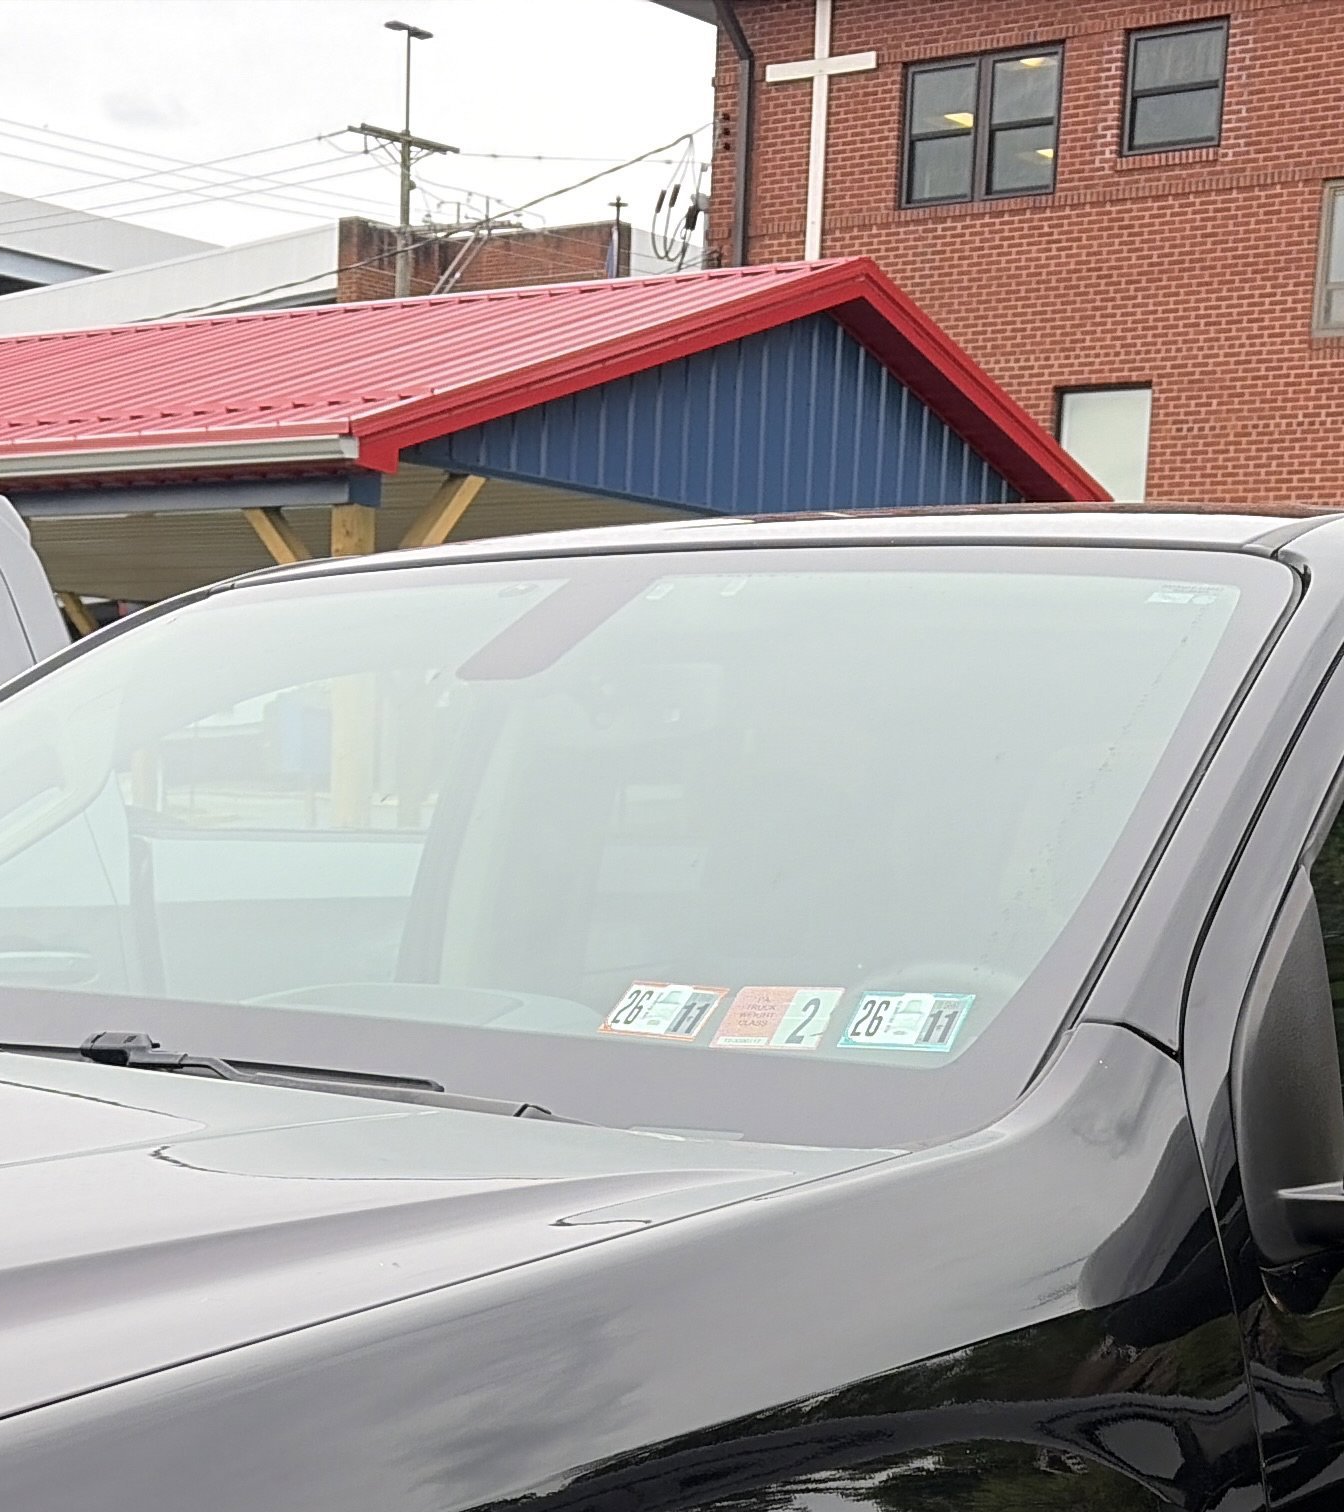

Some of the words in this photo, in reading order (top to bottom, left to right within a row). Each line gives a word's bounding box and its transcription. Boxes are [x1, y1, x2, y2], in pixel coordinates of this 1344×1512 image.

[610, 989, 655, 1025] 26
[671, 1002, 711, 1034] 11
[738, 1019, 769, 1027] CLASS
[746, 1003, 776, 1011] TRUCK
[785, 997, 821, 1045] 2
[849, 999, 891, 1037] 26
[922, 1009, 959, 1044] 11
